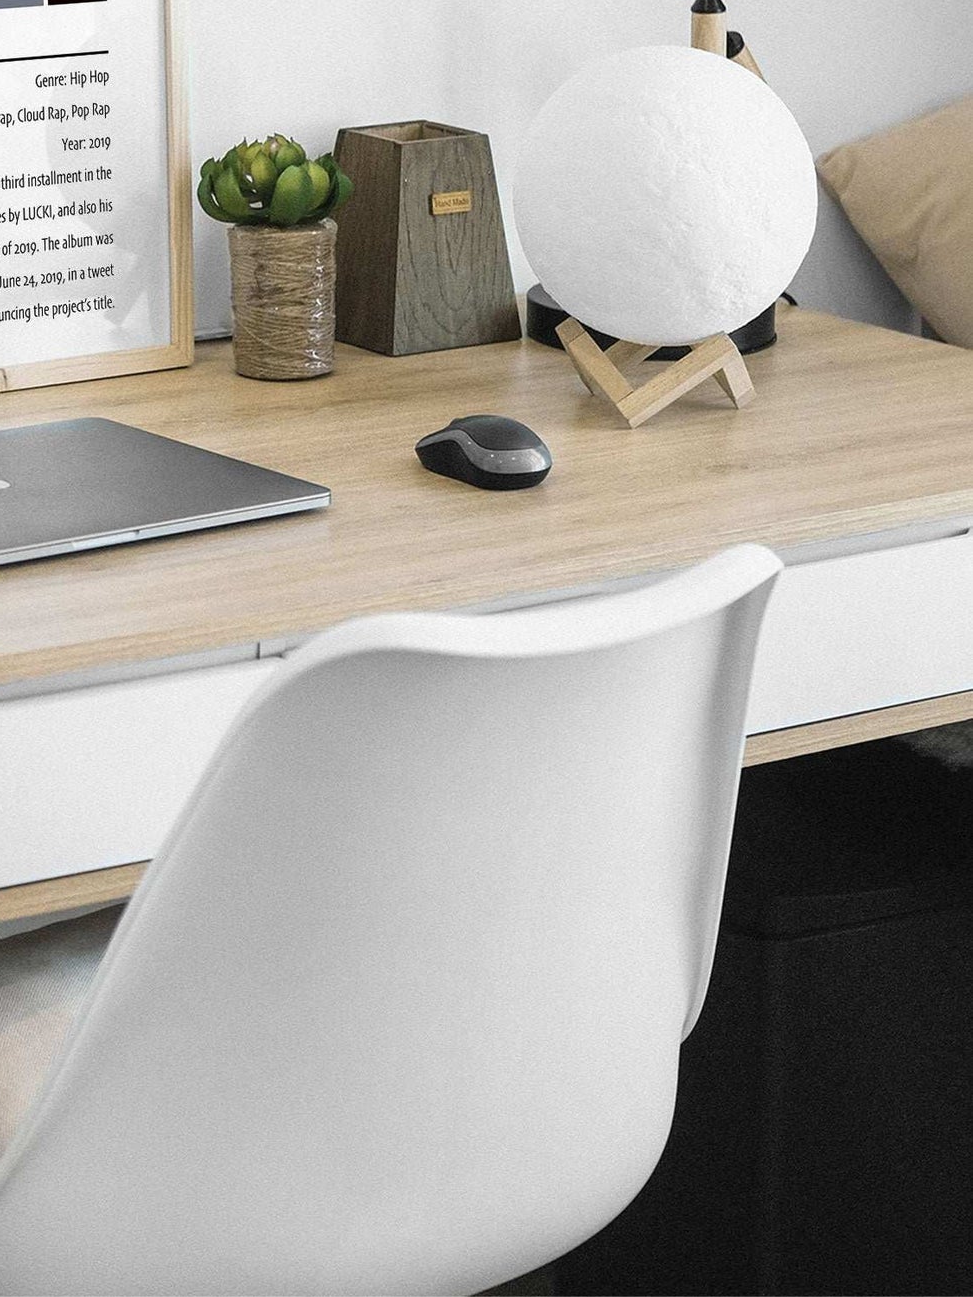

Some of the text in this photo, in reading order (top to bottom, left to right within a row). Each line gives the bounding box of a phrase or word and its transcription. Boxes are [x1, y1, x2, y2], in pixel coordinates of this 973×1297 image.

[35, 69, 110, 89] Genre: Hip Hop
[17, 106, 46, 123] Cloud
[47, 106, 69, 123] Rap,
[71, 104, 90, 121] Pop
[92, 102, 111, 119] Rap
[61, 136, 111, 152] Year: 2019
[0, 173, 25, 191] third
[27, 170, 83, 188] installment
[84, 170, 94, 182] in
[95, 165, 112, 181] the
[8, 207, 21, 226] by
[22, 204, 56, 221] LUCKI,
[57, 201, 76, 218] and
[77, 199, 97, 216] also
[98, 198, 113, 213] his
[1, 240, 13, 256] of
[14, 241, 40, 256] 2019.
[41, 236, 61, 251] The
[62, 233, 93, 250] album
[94, 233, 114, 246] was
[23, 274, 39, 288] 24,
[40, 271, 66, 286] 2019,
[67, 269, 78, 282] in
[79, 269, 86, 280] a
[87, 263, 115, 279] tweet
[33, 302, 50, 318] the
[93, 294, 115, 311] title.
